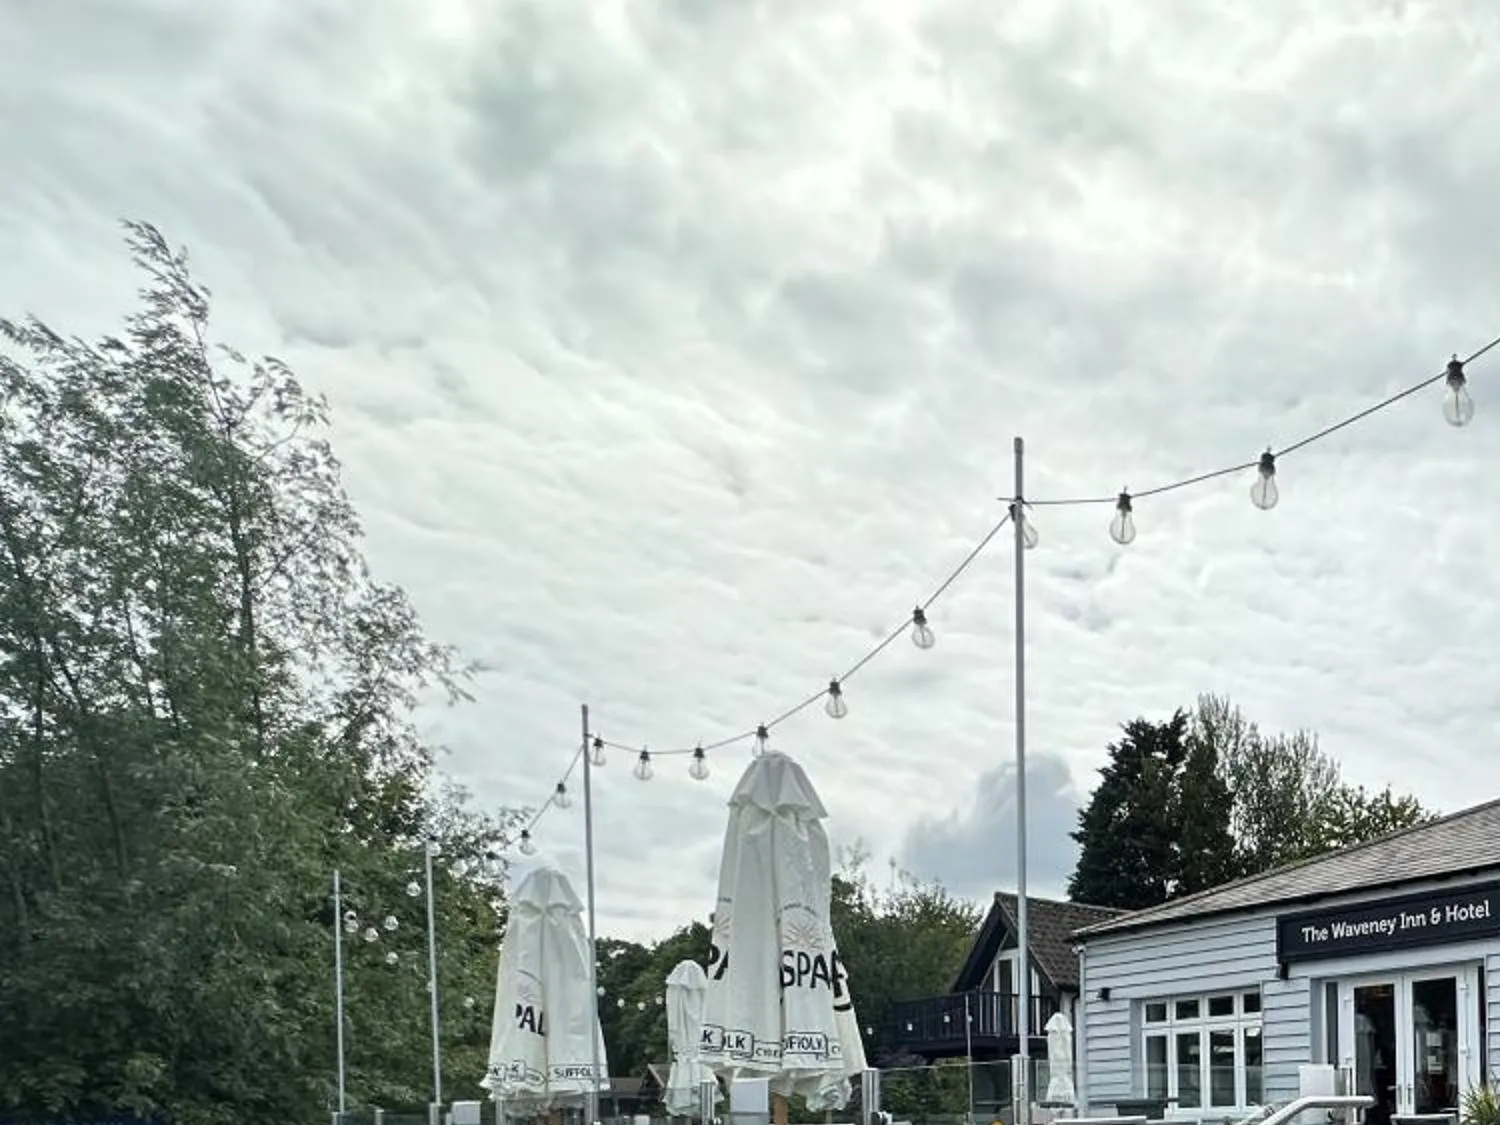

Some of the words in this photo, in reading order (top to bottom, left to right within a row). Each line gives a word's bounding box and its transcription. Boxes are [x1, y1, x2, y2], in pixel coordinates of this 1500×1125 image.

[1301, 926, 1328, 943] The
[1331, 915, 1397, 940] Waveney
[1400, 911, 1427, 929] Inn
[1430, 907, 1441, 925] &
[1445, 899, 1491, 923] Hotel
